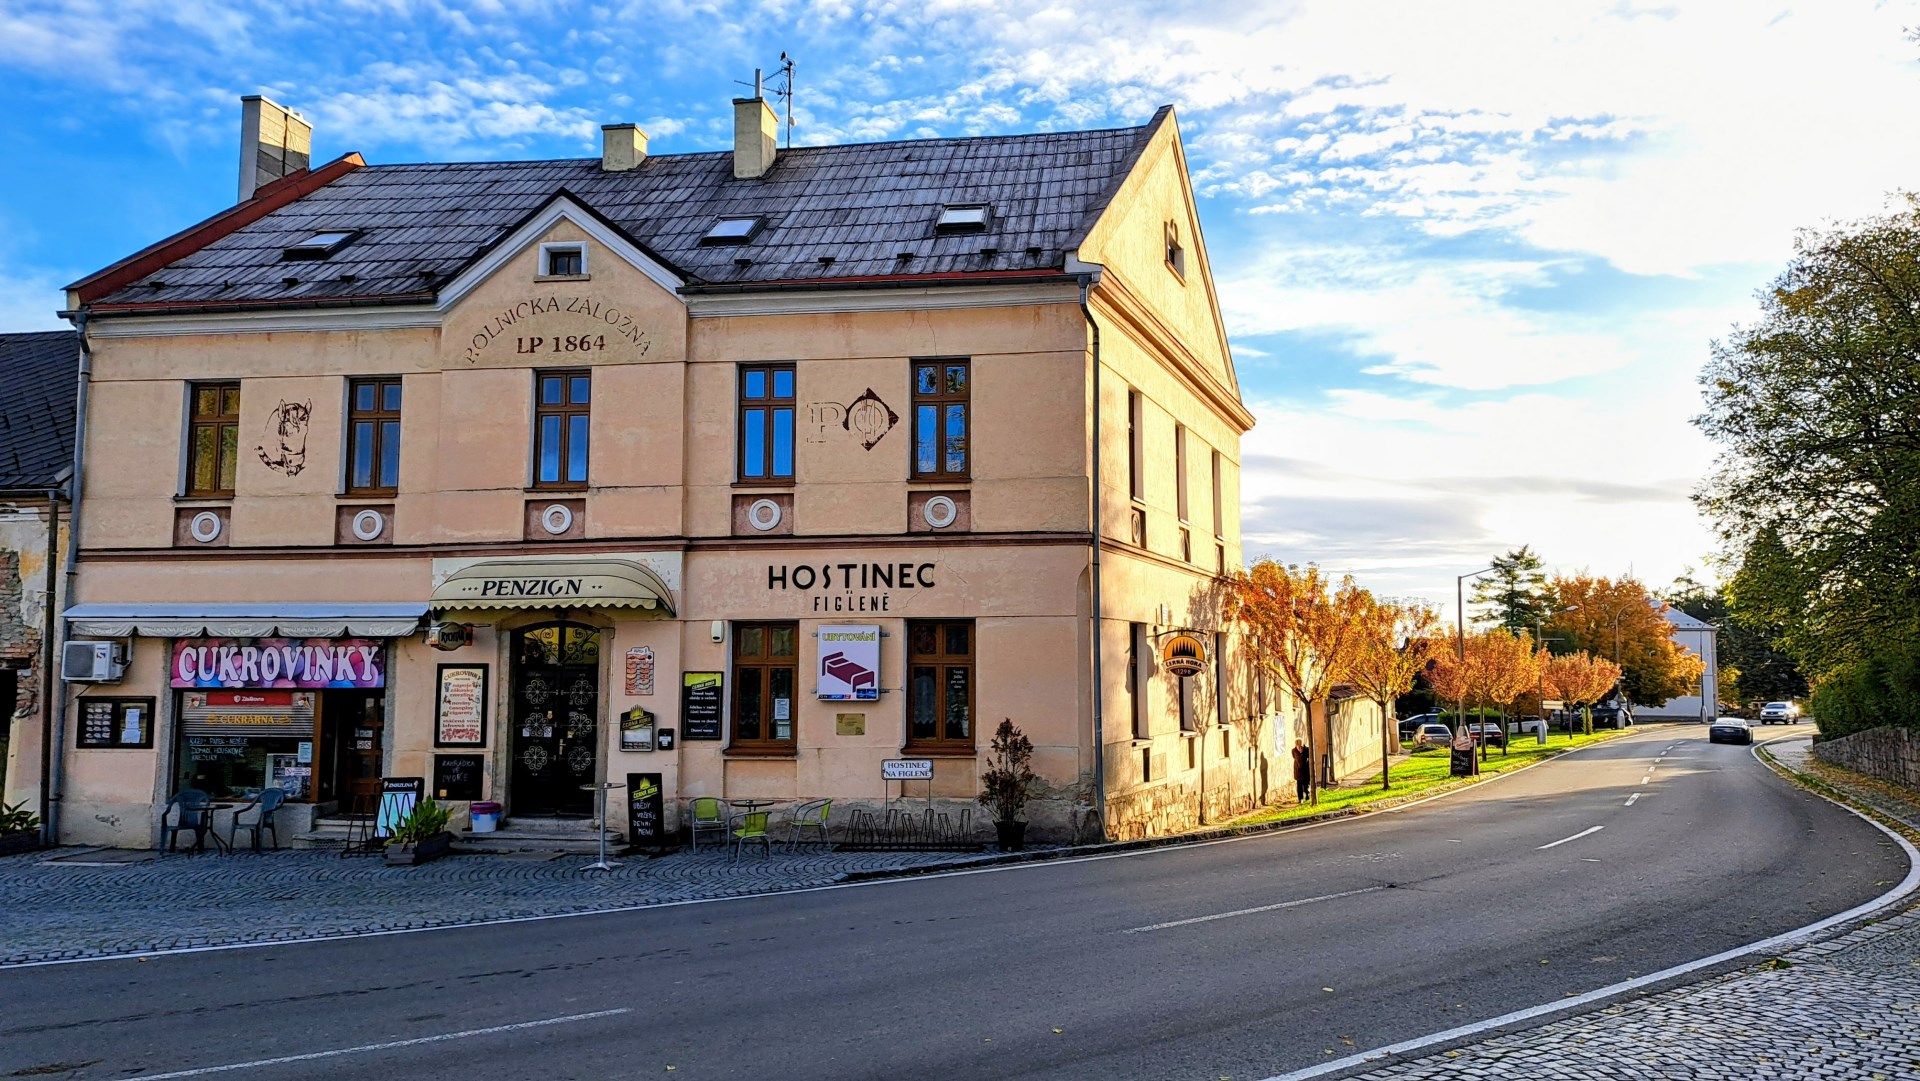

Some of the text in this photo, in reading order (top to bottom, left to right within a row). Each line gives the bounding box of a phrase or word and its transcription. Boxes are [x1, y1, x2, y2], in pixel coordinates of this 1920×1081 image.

[566, 296, 652, 356] ZÁLOŽNA
[517, 334, 607, 354] LP 1864
[480, 579, 583, 597] PENZION
[768, 563, 936, 590] HOSTINEC
[813, 592, 890, 612] FIGLENĚ
[178, 646, 379, 681] CUKROVINKY
